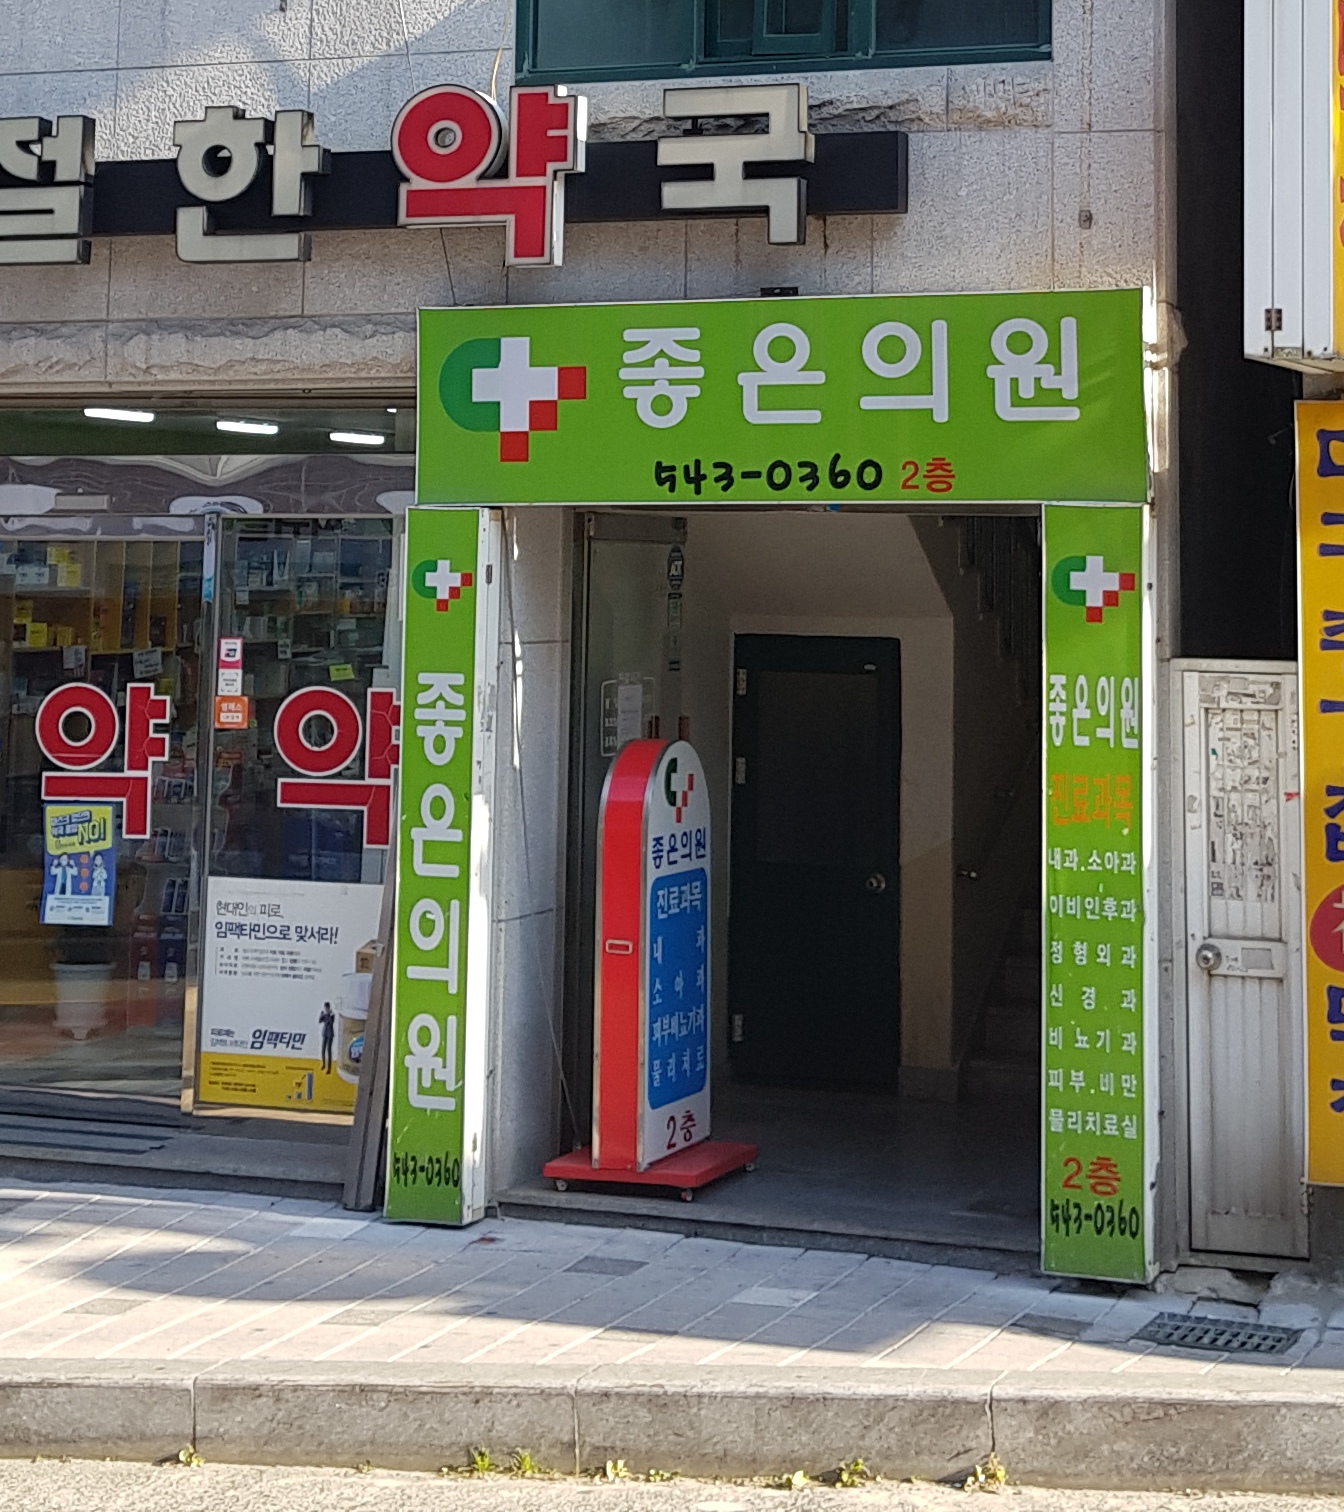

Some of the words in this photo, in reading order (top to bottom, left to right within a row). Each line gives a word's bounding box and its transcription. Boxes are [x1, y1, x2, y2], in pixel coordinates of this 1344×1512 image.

[617, 316, 1081, 429] 좋은의원
[654, 453, 883, 493] 543-0360
[900, 458, 956, 493] 2층
[1048, 673, 1140, 750] 좋은의원
[35, 682, 171, 840] 약
[273, 686, 401, 849] 약
[651, 827, 707, 870] 좋은의원
[406, 672, 467, 1113] 좋은의원
[656, 880, 702, 920] 진료과목
[1048, 894, 1137, 923] 이비인후과
[666, 1110, 697, 1151] 2층
[1048, 1108, 1138, 1140] 물리치료실
[393, 1150, 460, 1188] 543-0360
[1061, 1155, 1123, 1198] 2층
[1050, 1198, 1140, 1240] 543-0360
